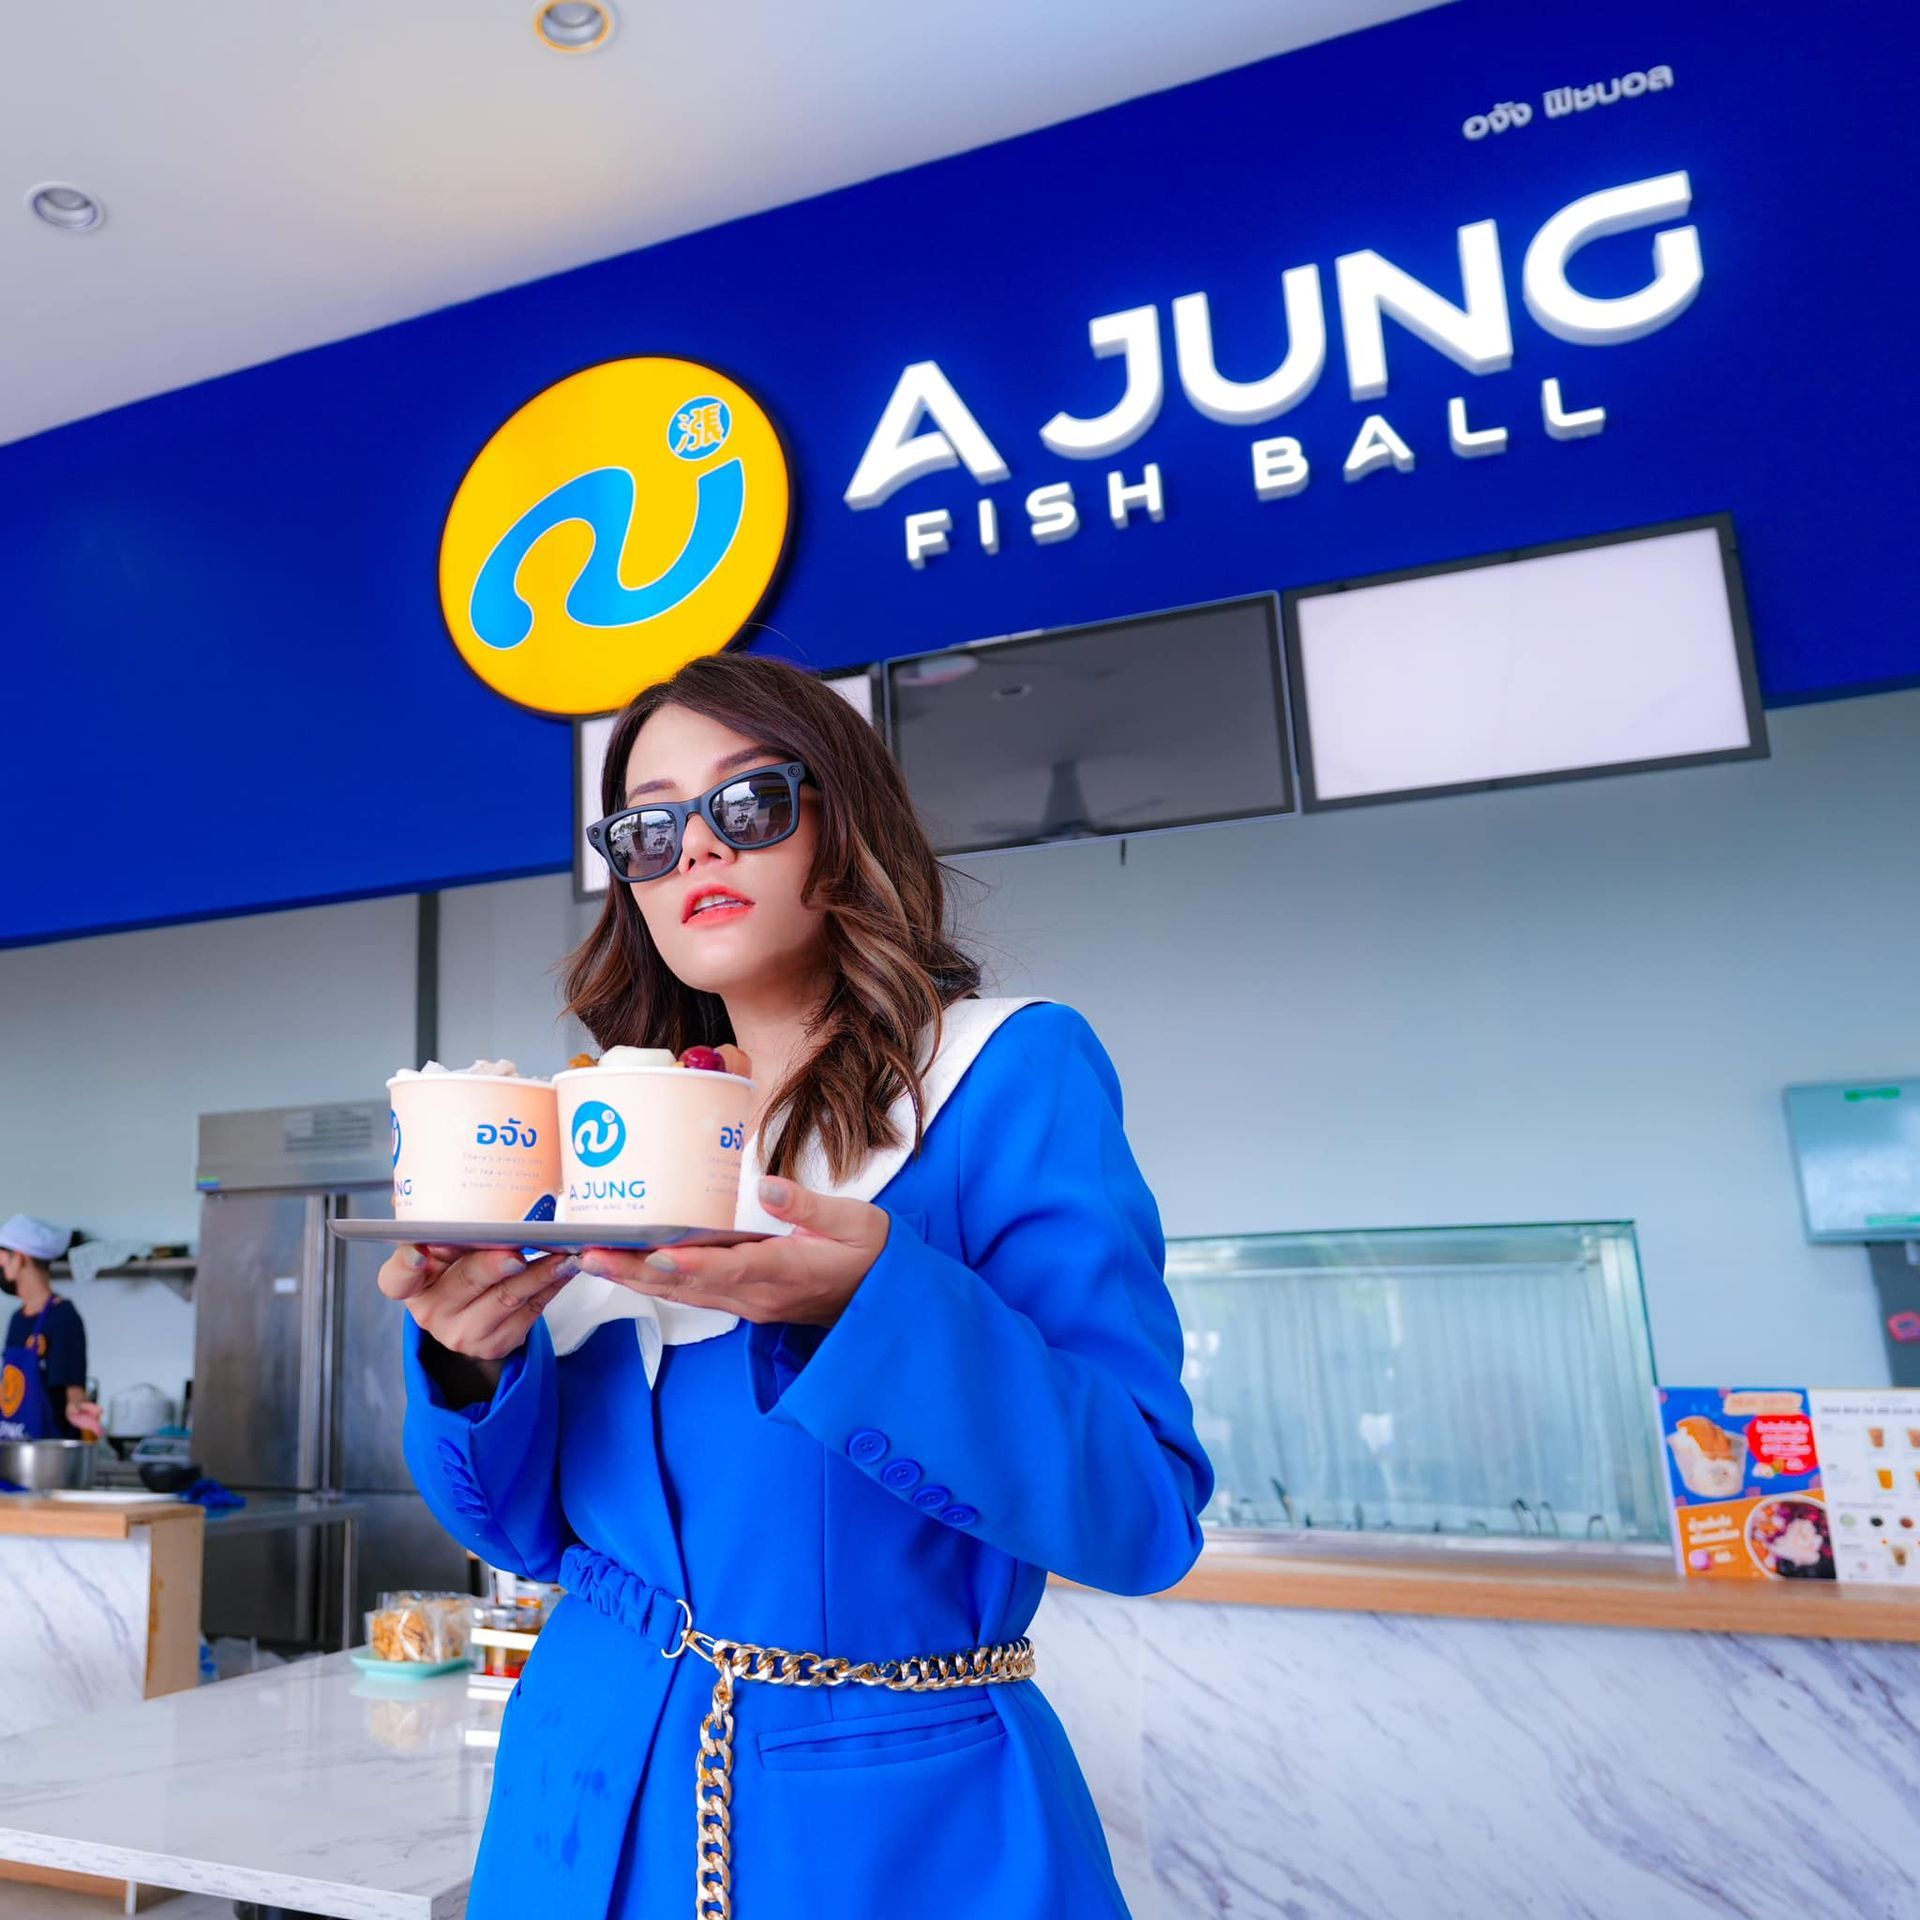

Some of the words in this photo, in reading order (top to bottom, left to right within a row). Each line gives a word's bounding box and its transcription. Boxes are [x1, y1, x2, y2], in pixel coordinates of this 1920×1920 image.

[1462, 101, 1533, 140] อจัง
[844, 360, 1010, 510] A
[1040, 170, 1703, 461] JUNG
[905, 463, 1164, 569] FISH
[1251, 378, 1606, 501] BALL
[476, 1117, 538, 1148] อจัง
[582, 1180, 646, 1199] JUNG
